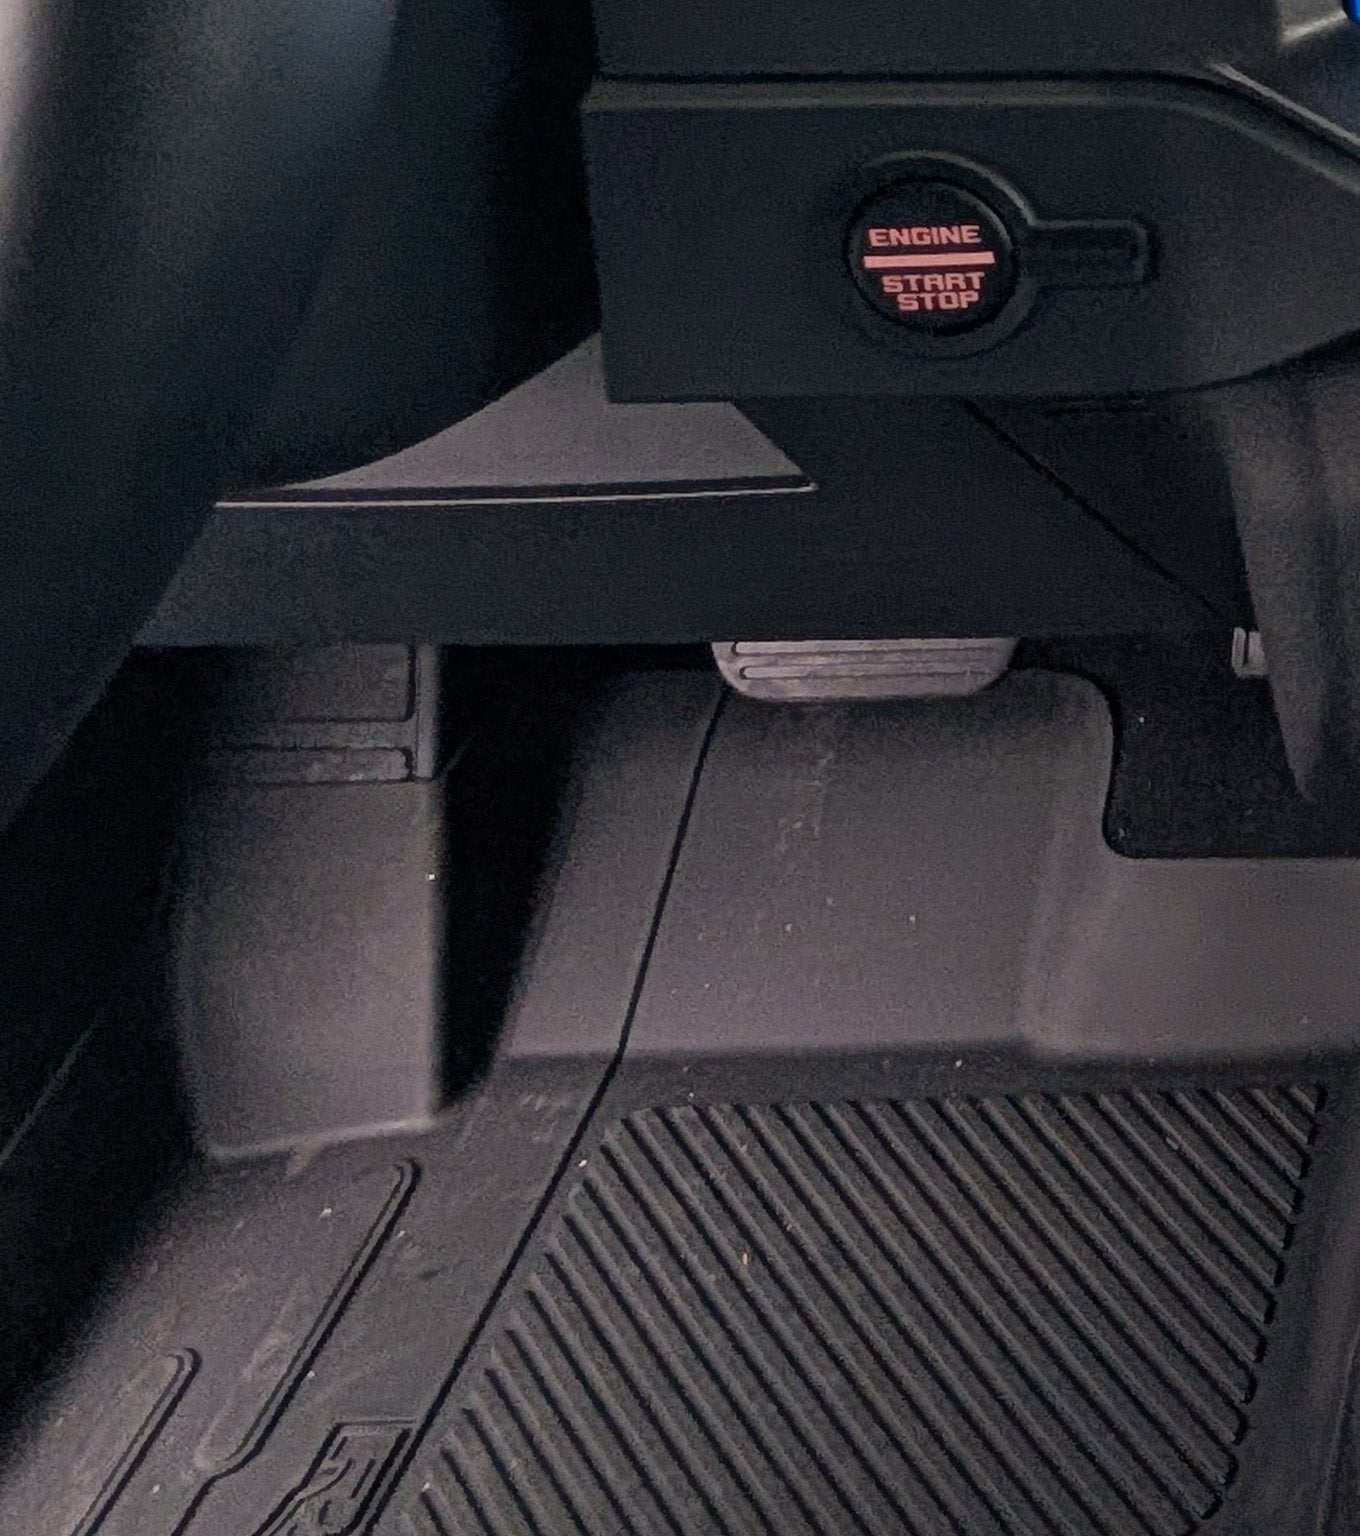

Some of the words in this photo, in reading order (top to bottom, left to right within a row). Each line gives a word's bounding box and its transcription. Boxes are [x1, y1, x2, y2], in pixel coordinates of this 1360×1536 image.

[867, 224, 982, 247] ENGINE
[881, 271, 986, 293] START
[896, 290, 980, 312] STOP
